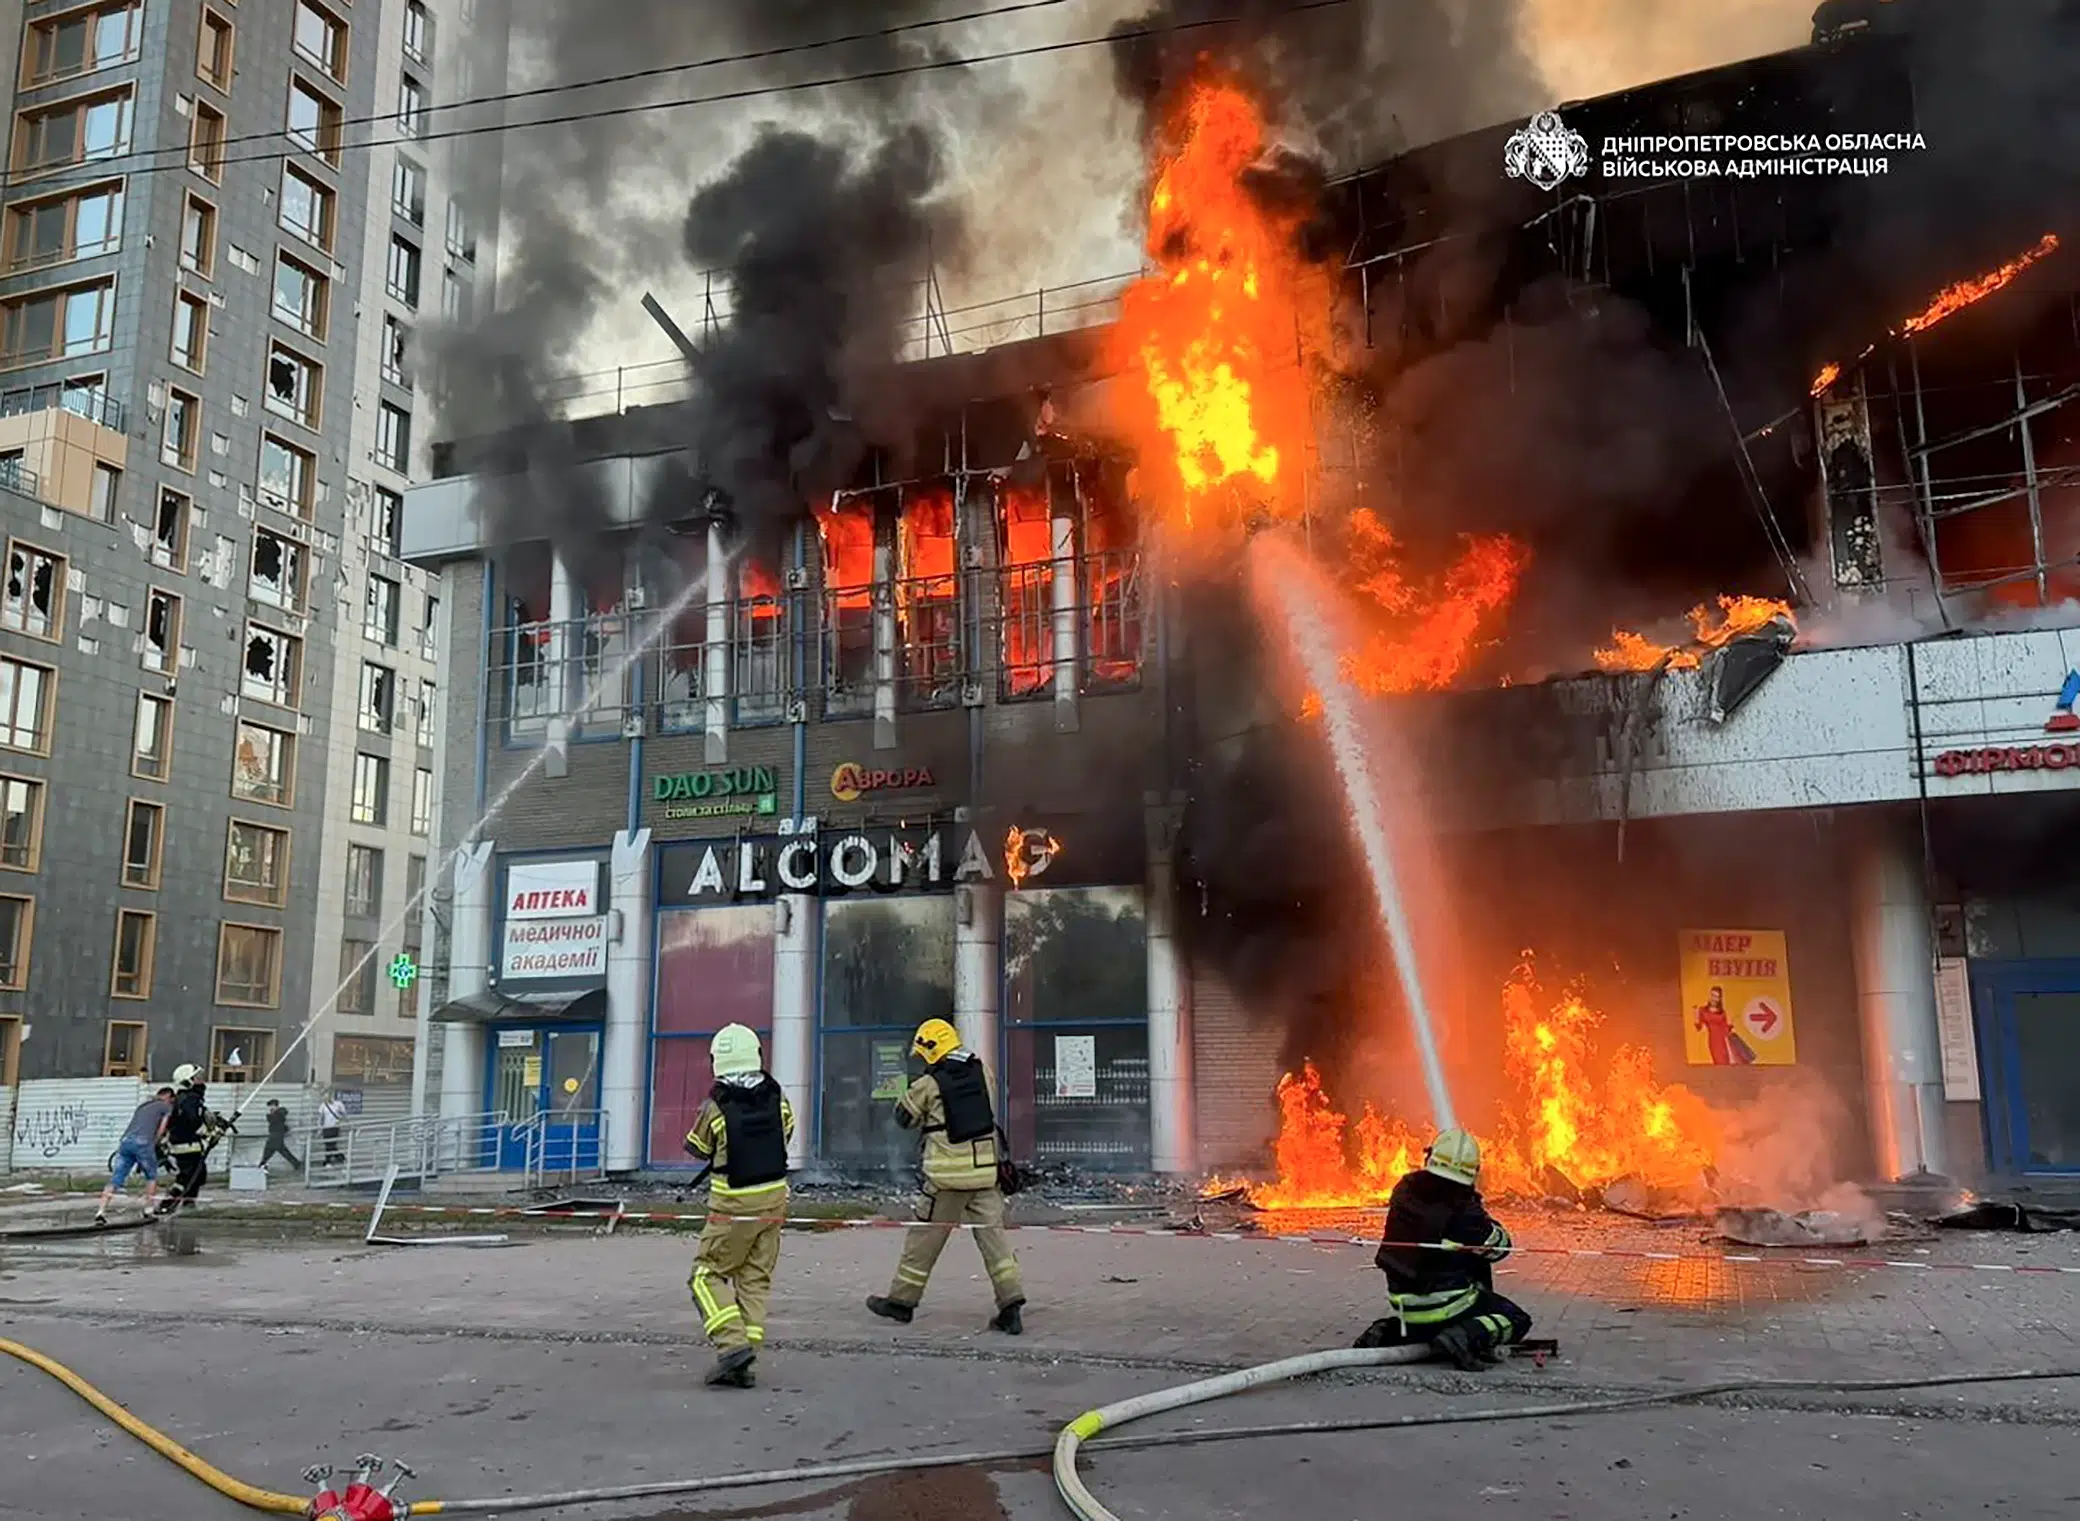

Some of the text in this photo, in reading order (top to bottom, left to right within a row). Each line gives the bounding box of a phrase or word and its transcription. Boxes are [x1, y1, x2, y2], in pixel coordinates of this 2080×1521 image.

[654, 765, 776, 800] DAO SUN
[688, 828, 1053, 896] ALCOMAG
[512, 889, 588, 911] АПТЕКА
[508, 918, 604, 943] медичної
[510, 946, 600, 972] академії
